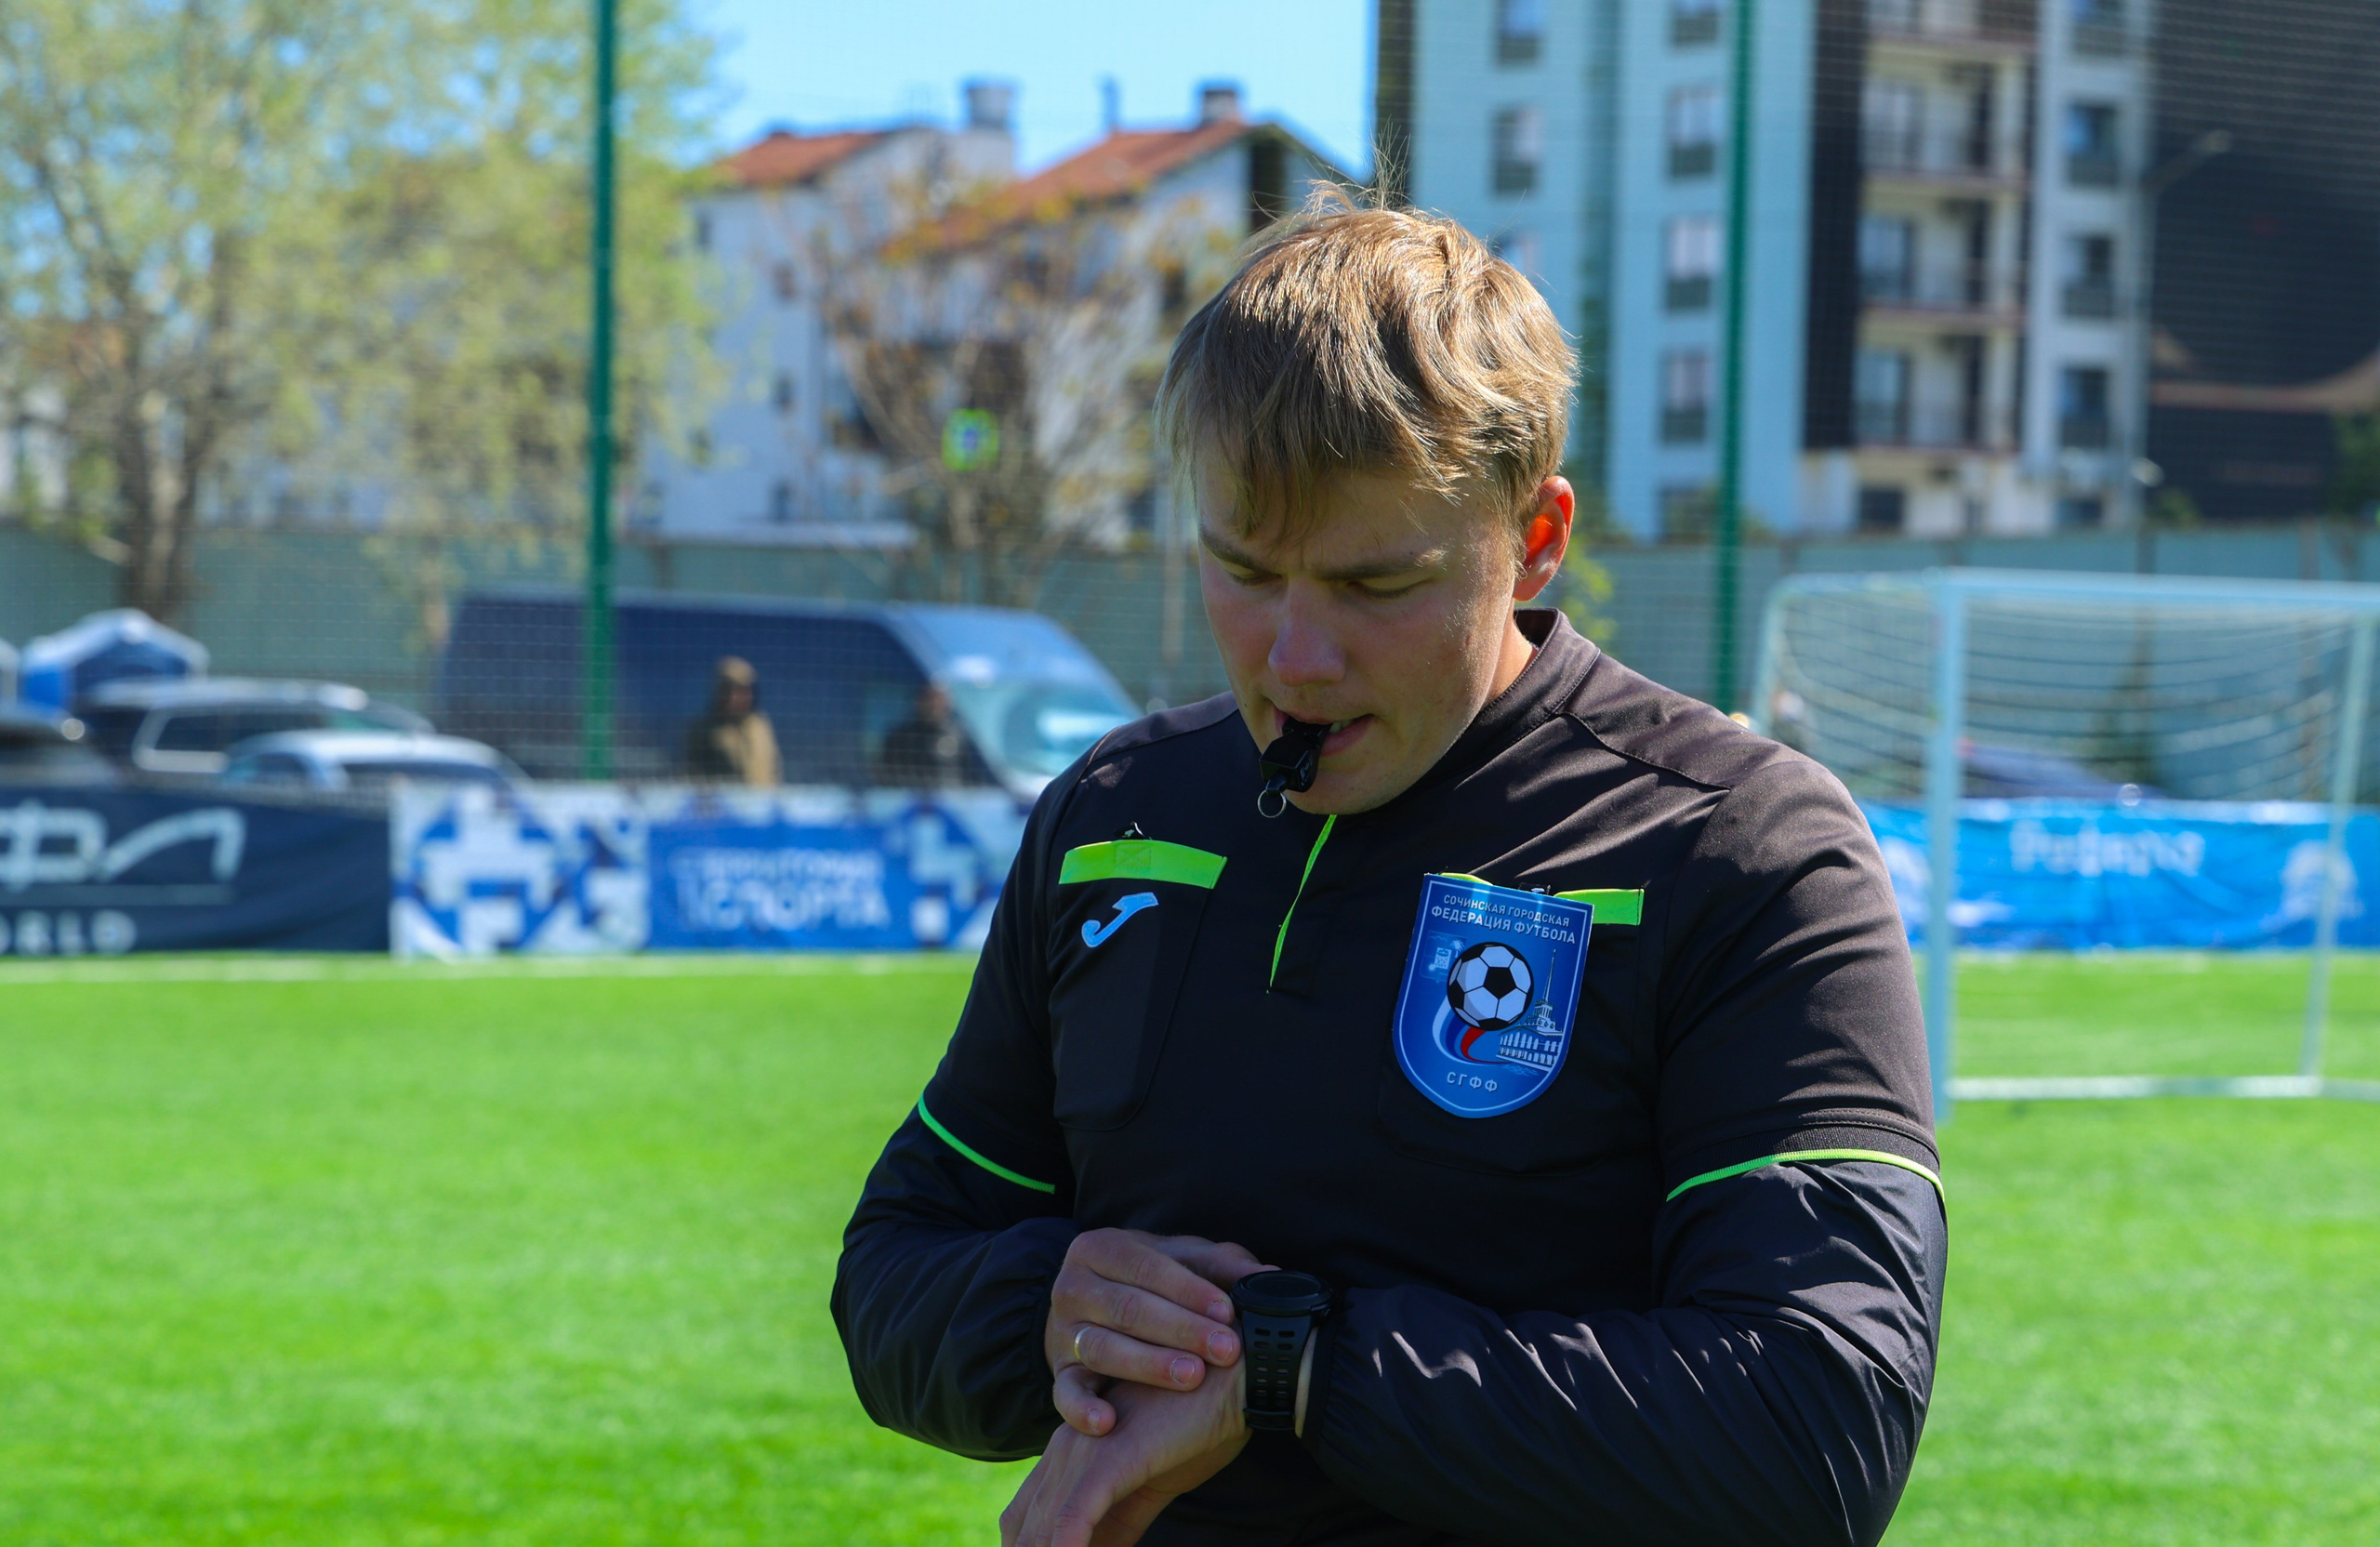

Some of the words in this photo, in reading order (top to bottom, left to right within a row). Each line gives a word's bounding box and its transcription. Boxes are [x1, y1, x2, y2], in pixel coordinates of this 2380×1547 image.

[1432, 906, 1511, 931] ФЕДЕРАЦИЯ
[1514, 921, 1576, 944] ФУТБОЛА
[1444, 894, 1506, 915] СОЧИНСКАЯ
[1508, 906, 1570, 927] ГОРОДСКАЯ
[1447, 1072, 1498, 1091] СГФФ
